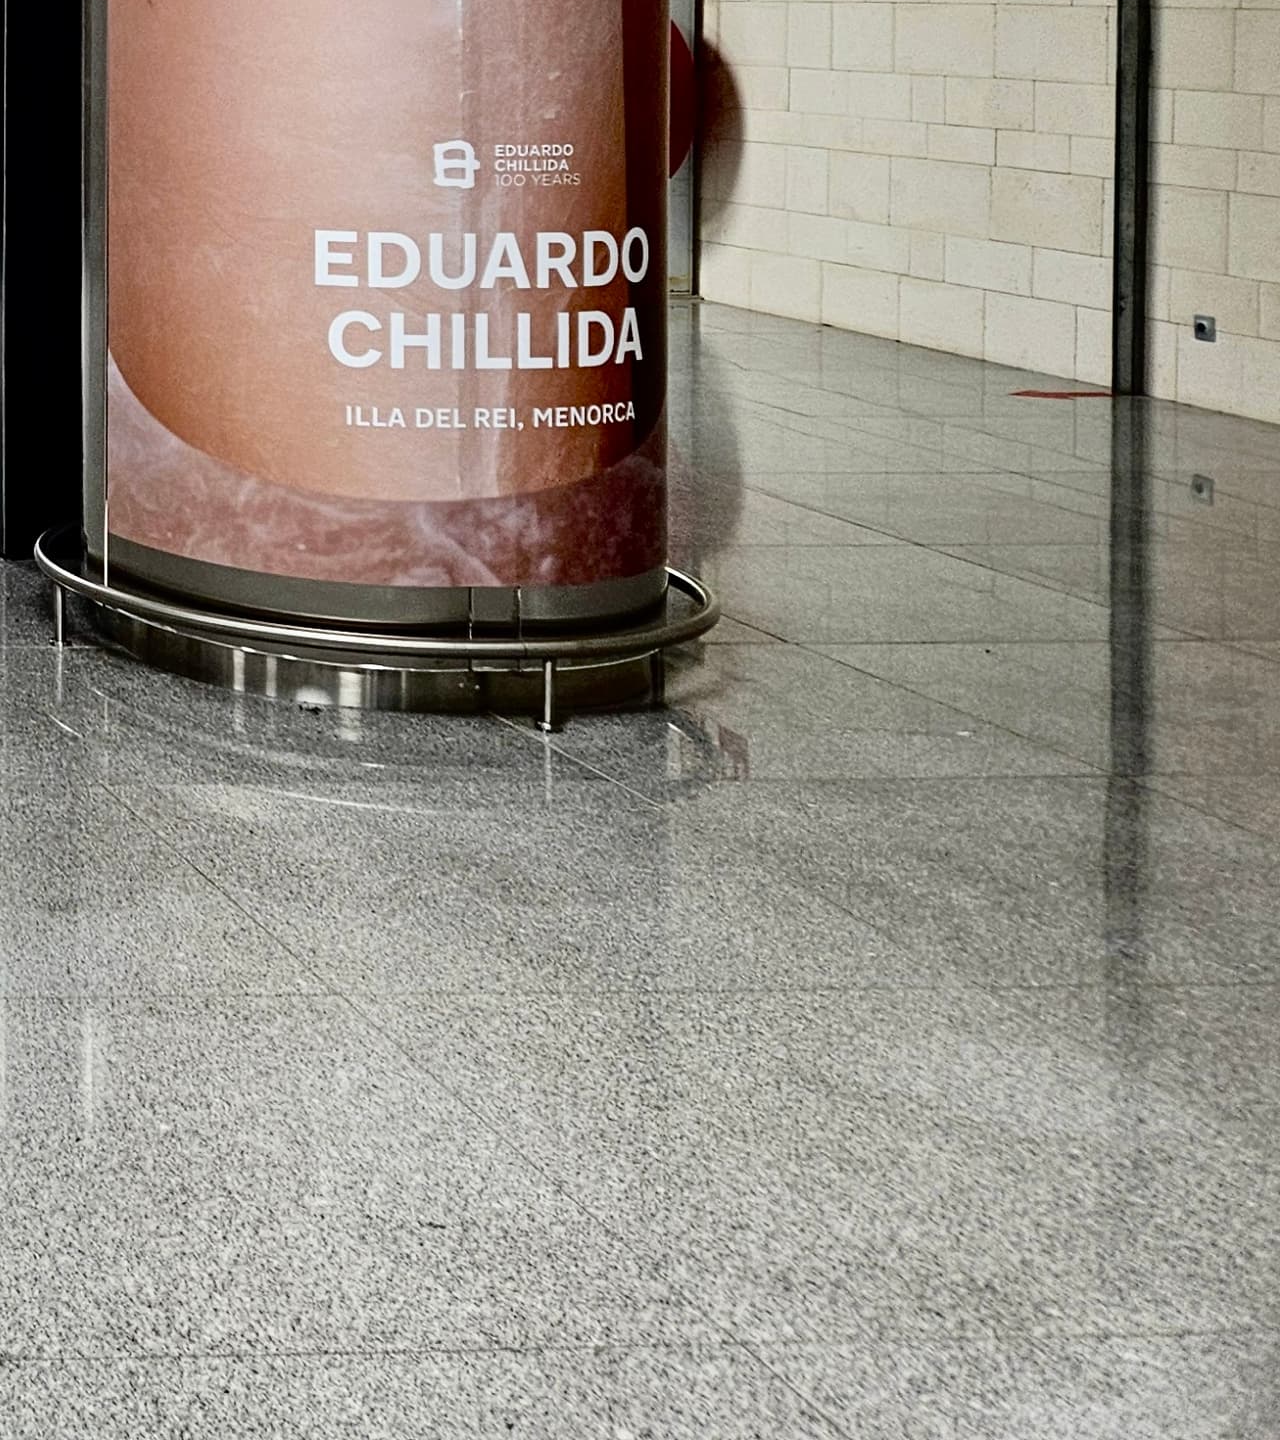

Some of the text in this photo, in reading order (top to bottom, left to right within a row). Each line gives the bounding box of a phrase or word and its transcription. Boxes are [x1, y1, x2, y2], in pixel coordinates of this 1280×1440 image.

[494, 143, 575, 157] EDUARDO
[494, 158, 570, 172] CHILLIDA
[495, 172, 582, 187] 100 YEARS
[313, 225, 650, 291] EDUARDO
[326, 306, 644, 371] CHILLIDA
[345, 398, 637, 433] ILLA DEL REI, MENORCA
